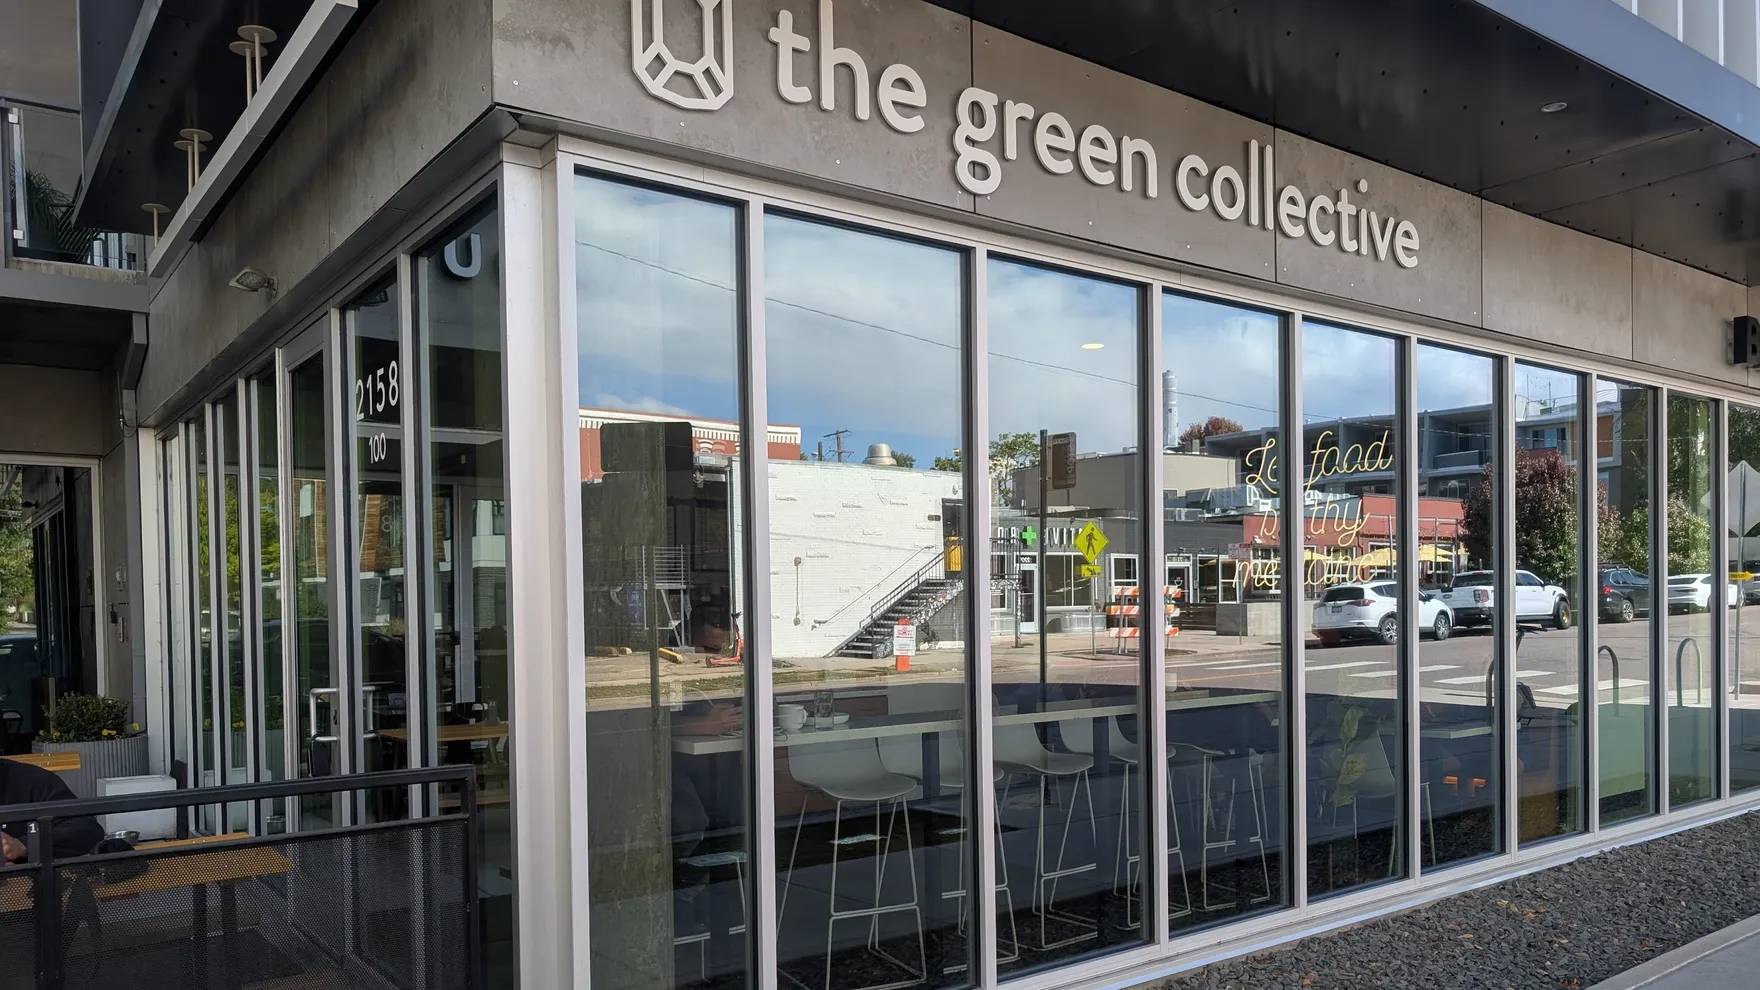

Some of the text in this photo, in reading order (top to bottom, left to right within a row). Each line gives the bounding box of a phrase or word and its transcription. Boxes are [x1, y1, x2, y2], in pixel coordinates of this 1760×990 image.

[768, 0, 1421, 270] the green collective
[355, 360, 399, 421] 2158
[368, 432, 387, 464] 100
[1245, 430, 1394, 497] Le food
[1309, 494, 1371, 547] thy
[1231, 546, 1377, 588] mecine
